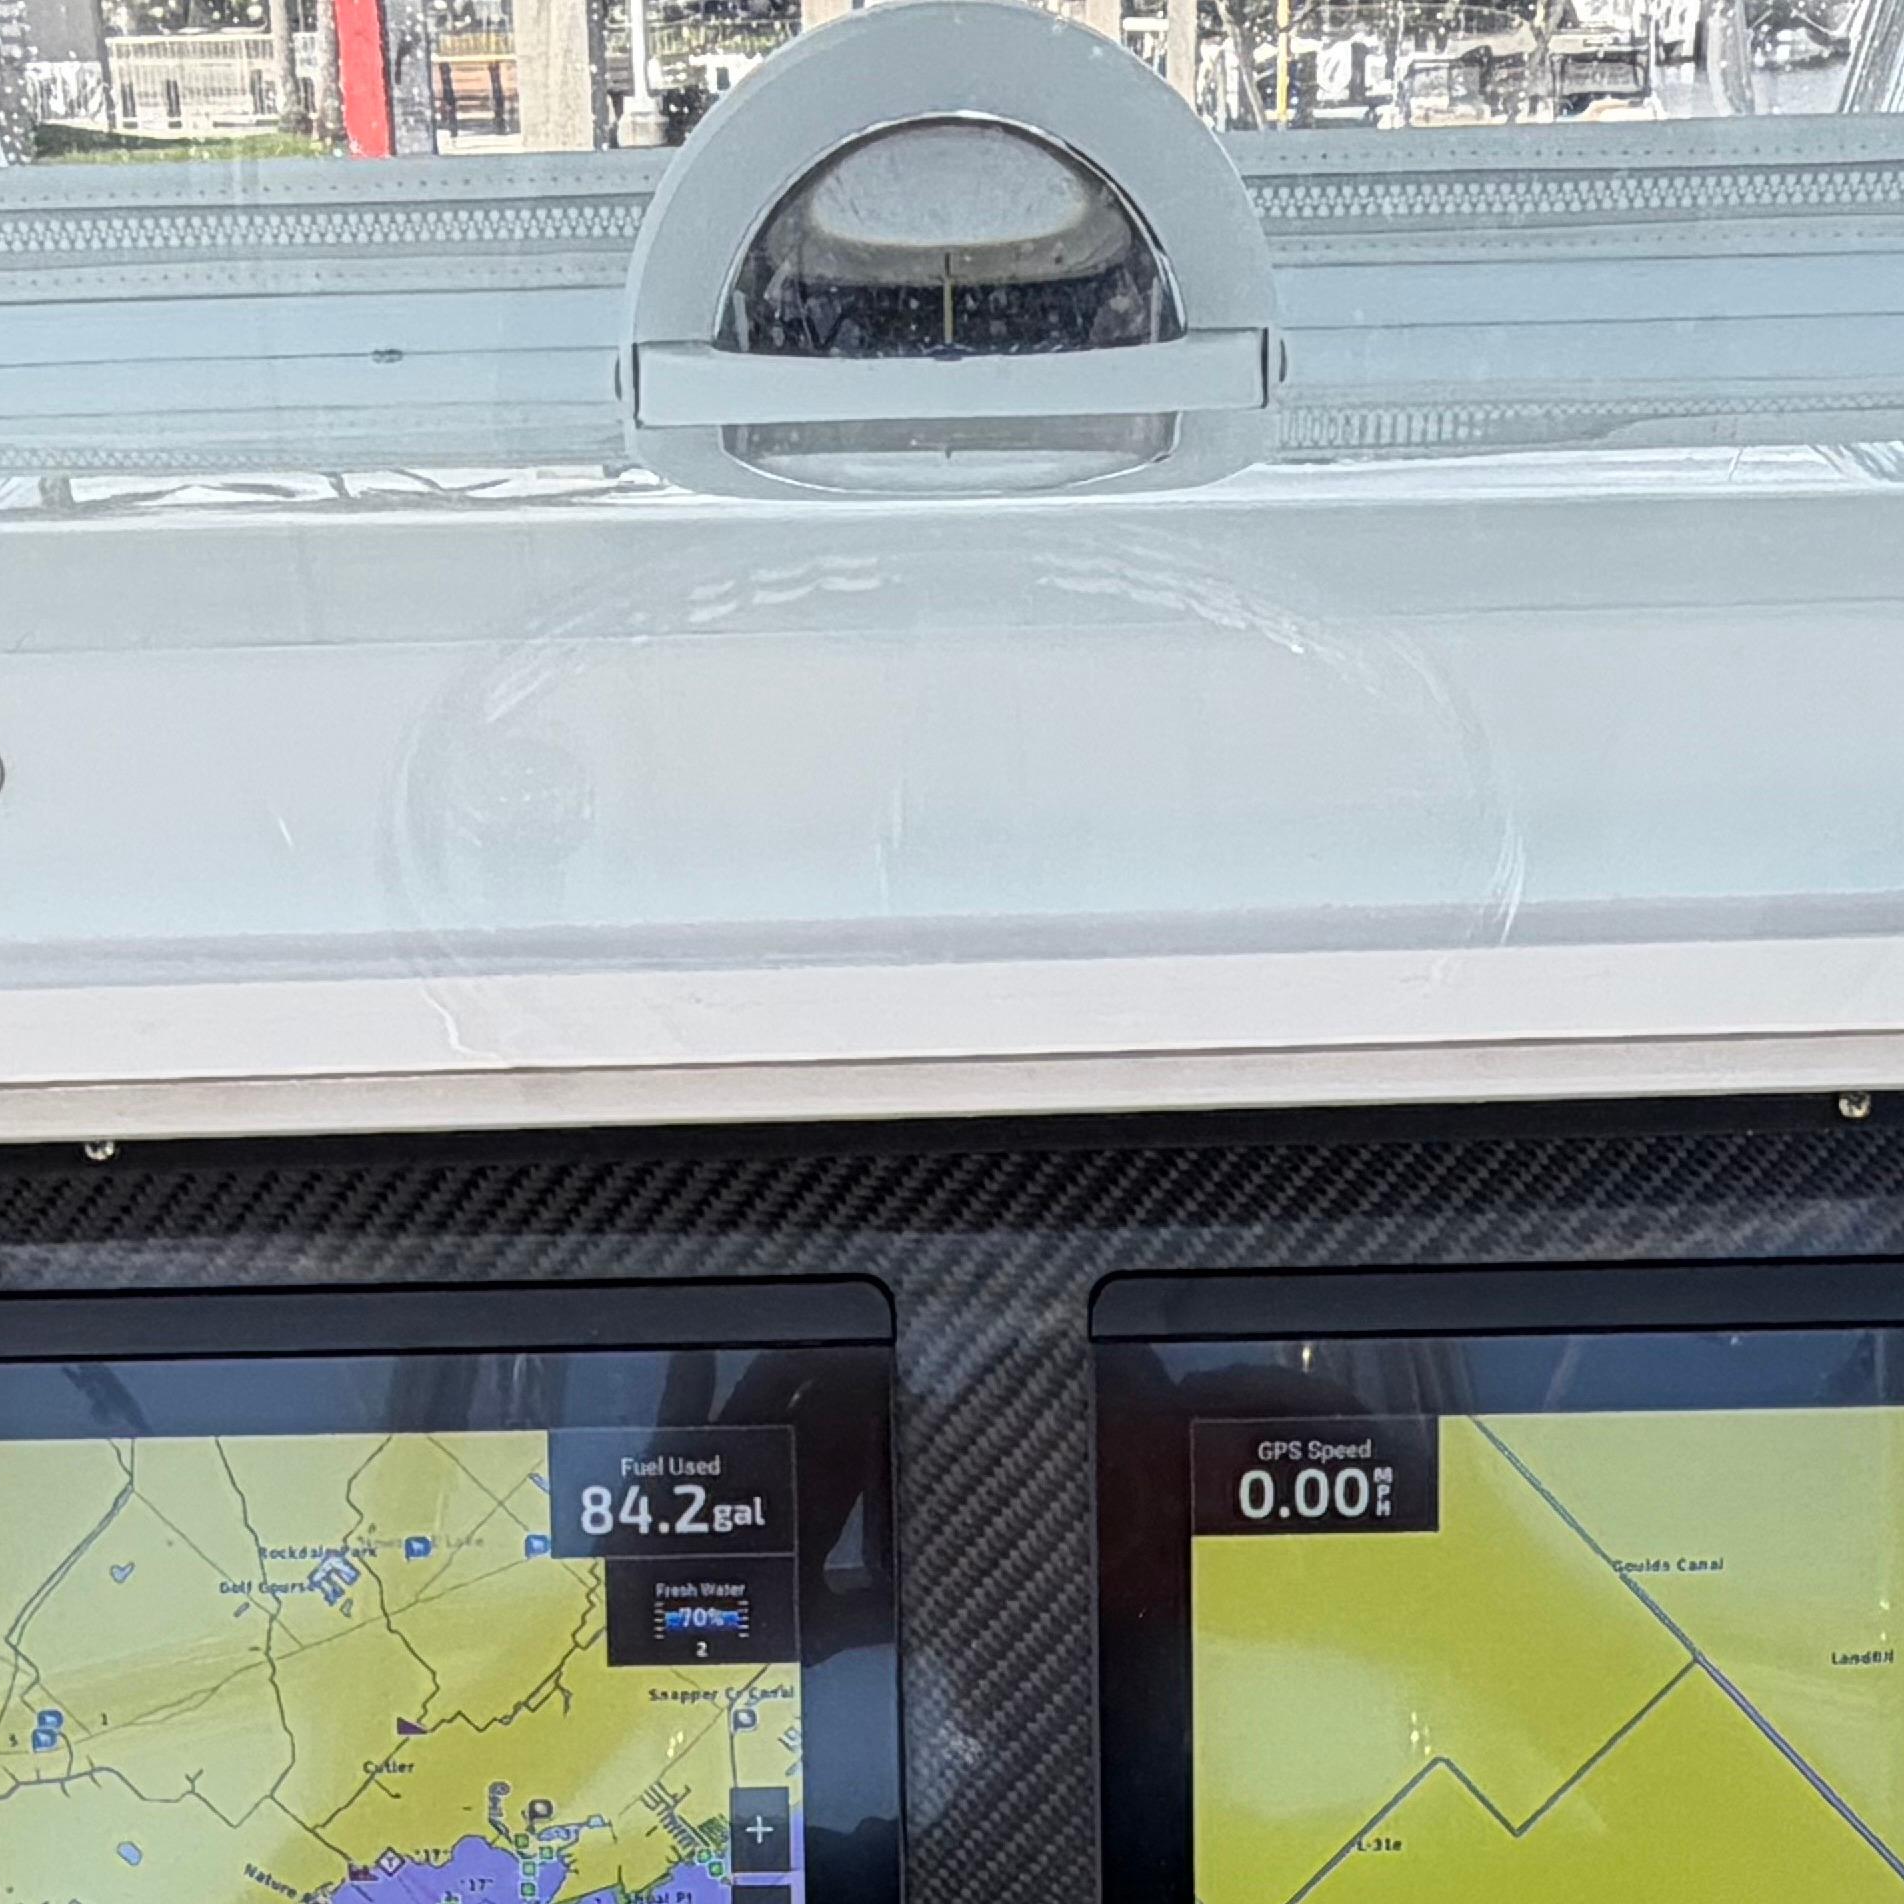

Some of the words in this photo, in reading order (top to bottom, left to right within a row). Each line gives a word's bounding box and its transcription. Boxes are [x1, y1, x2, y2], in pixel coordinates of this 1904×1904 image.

[1258, 1440, 1302, 1461] GPS
[1308, 1438, 1373, 1464] Speed
[621, 1457, 664, 1477] Fuel
[668, 1455, 721, 1476] Used
[1239, 1468, 1370, 1519] 0.00
[1677, 1557, 1724, 1573] Canal
[655, 1583, 696, 1598] Fresh
[701, 1583, 746, 1598] Water
[679, 1607, 724, 1628] 70%
[697, 1642, 708, 1657] 2
